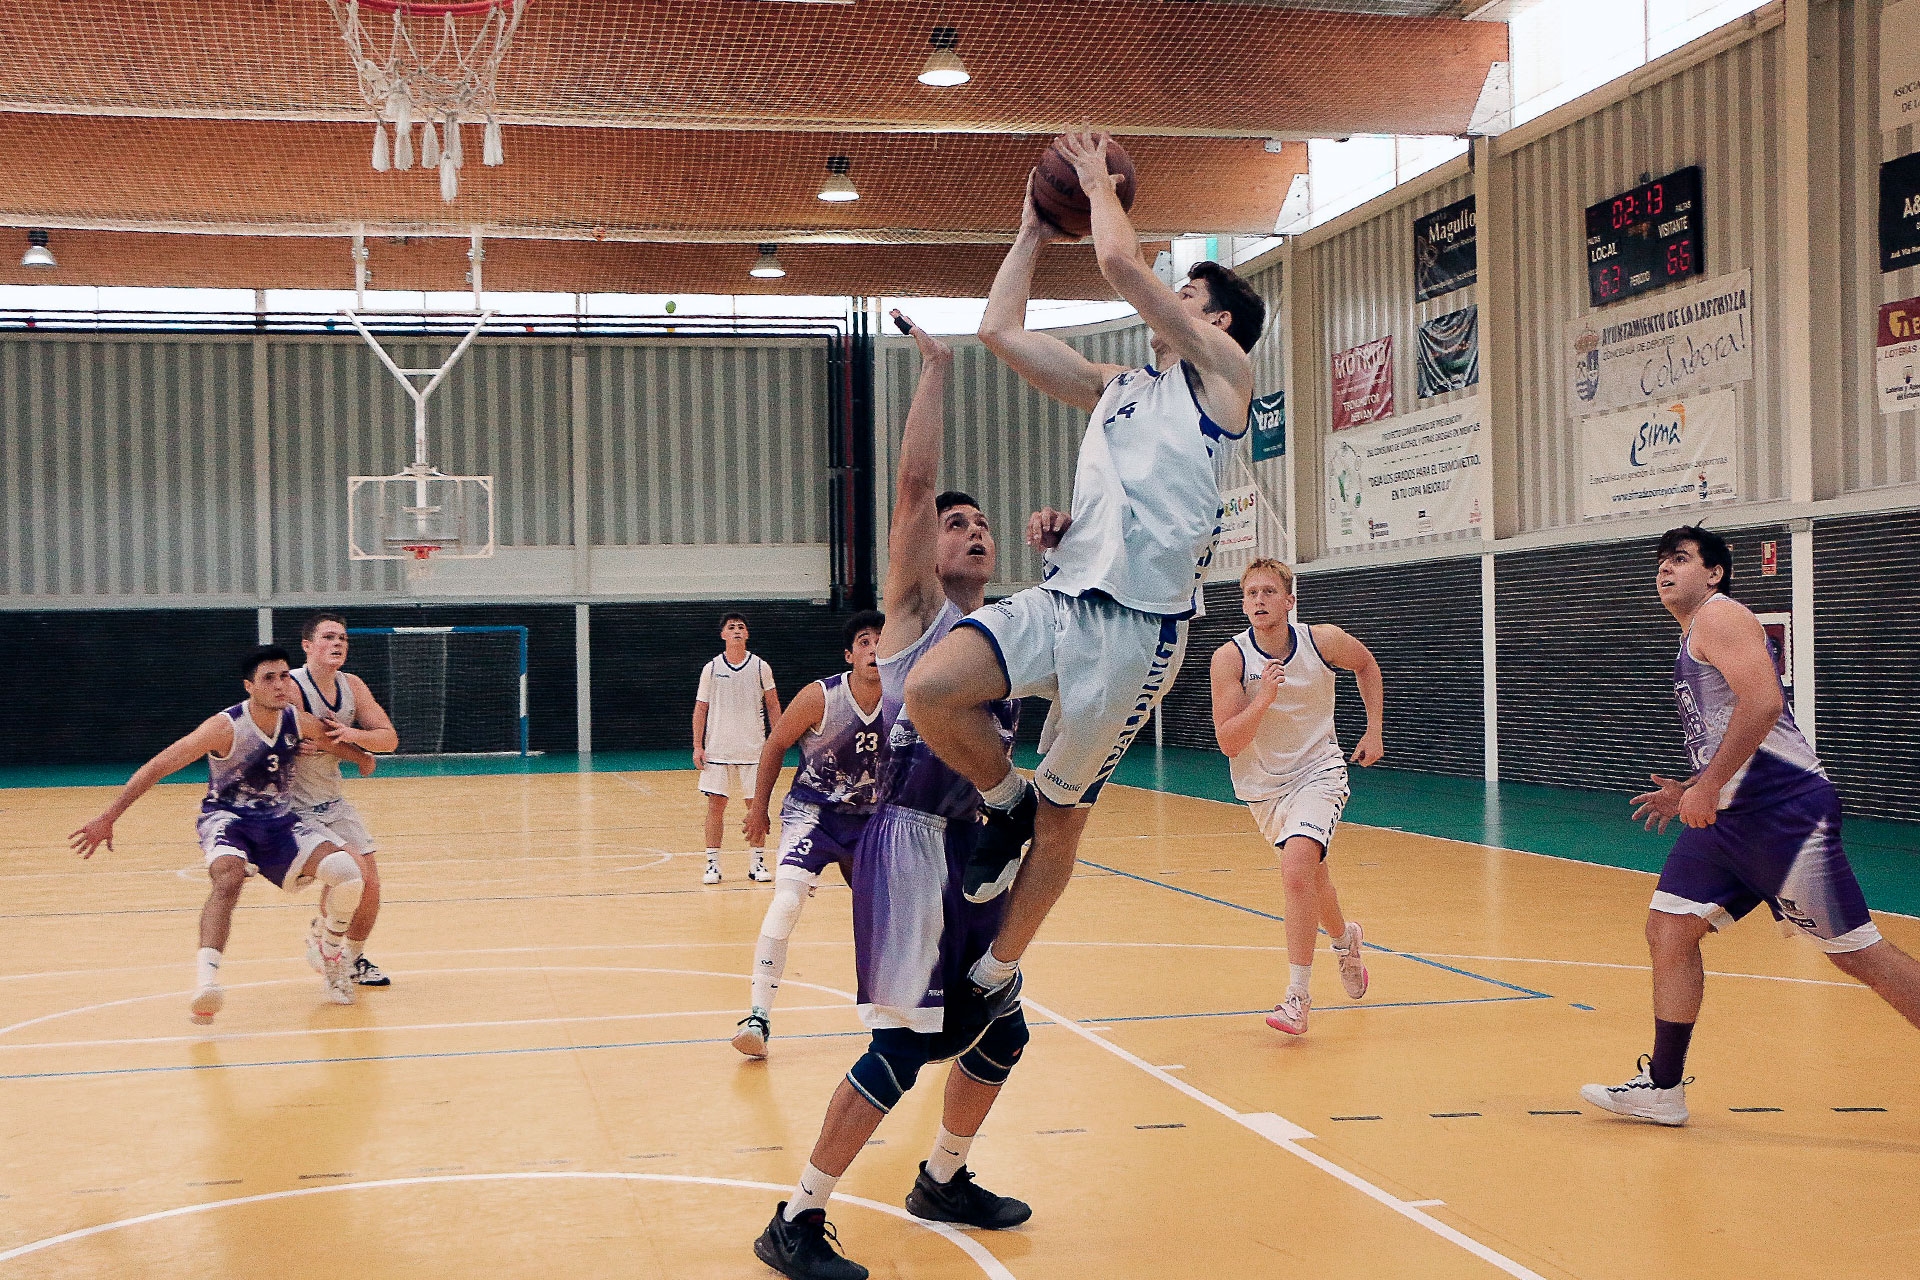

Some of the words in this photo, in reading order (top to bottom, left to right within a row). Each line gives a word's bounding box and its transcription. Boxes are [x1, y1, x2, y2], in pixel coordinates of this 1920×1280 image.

[1612, 184, 1663, 229] 02:13
[1658, 216, 1689, 239] VISITANTE
[1592, 243, 1618, 263] LOCAL
[1602, 312, 1666, 346] AYUNTAMIENTO
[1667, 309, 1680, 329] DE
[1681, 305, 1693, 326] LA
[1695, 289, 1747, 322] LASTRILLA
[1638, 412, 1681, 451] sima
[855, 732, 878, 753] 23
[266, 754, 279, 772] 3
